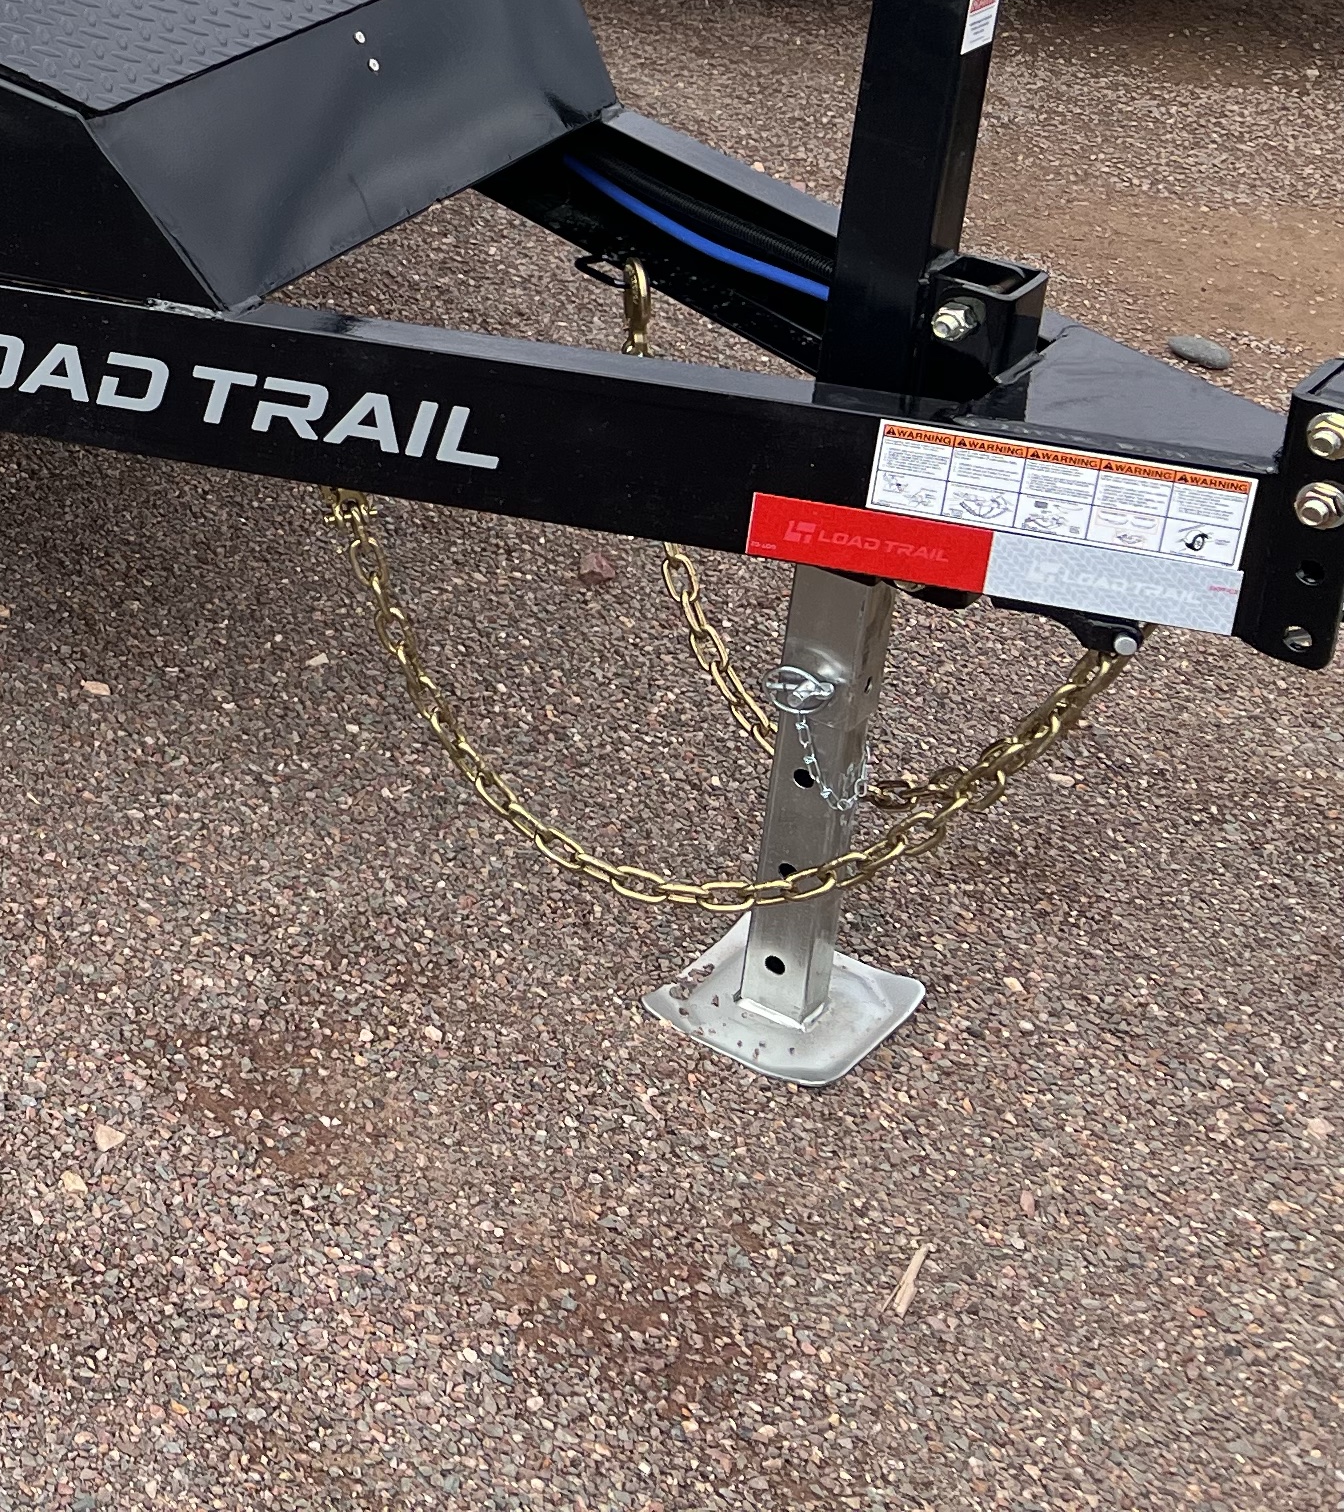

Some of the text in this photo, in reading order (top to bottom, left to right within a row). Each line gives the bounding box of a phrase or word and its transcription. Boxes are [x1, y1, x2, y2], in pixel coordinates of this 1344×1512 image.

[193, 365, 499, 469] TRAIL
[897, 428, 952, 445] WARNING
[968, 440, 1024, 457] WARNING
[1040, 452, 1098, 469] WARNING
[1115, 465, 1172, 481] WARNING
[1189, 476, 1248, 493] WARNING
[817, 529, 949, 563] LOAD TRAIL
